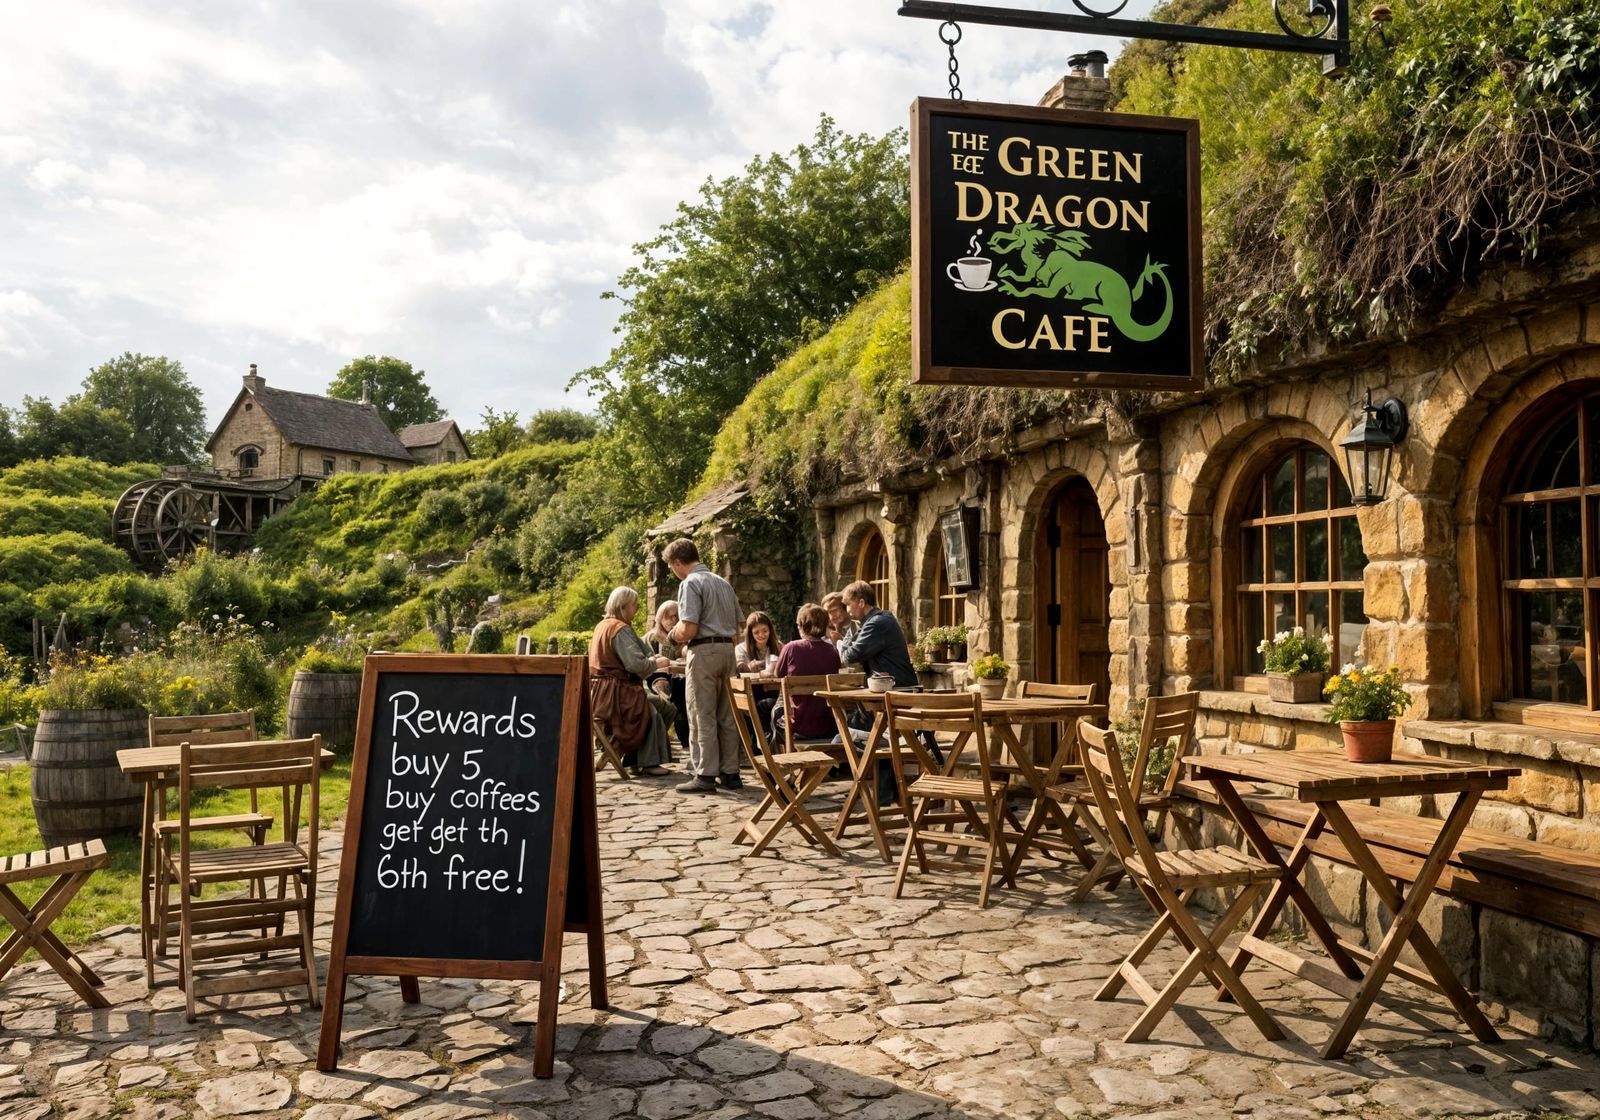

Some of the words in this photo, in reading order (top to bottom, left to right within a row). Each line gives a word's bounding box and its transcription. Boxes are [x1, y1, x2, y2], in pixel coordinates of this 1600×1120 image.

[947, 130, 990, 152] THE
[997, 136, 1143, 184] GREEN
[954, 181, 1151, 233] DRAGON
[991, 308, 1112, 353] CAFE
[388, 690, 537, 739] Rewards
[391, 741, 450, 789] buy
[461, 748, 484, 781] 5
[385, 778, 436, 824] buy
[450, 777, 541, 813] coffees
[428, 817, 469, 855] get
[477, 816, 509, 846] th
[377, 853, 428, 890] 6th
[443, 838, 526, 895] free!
